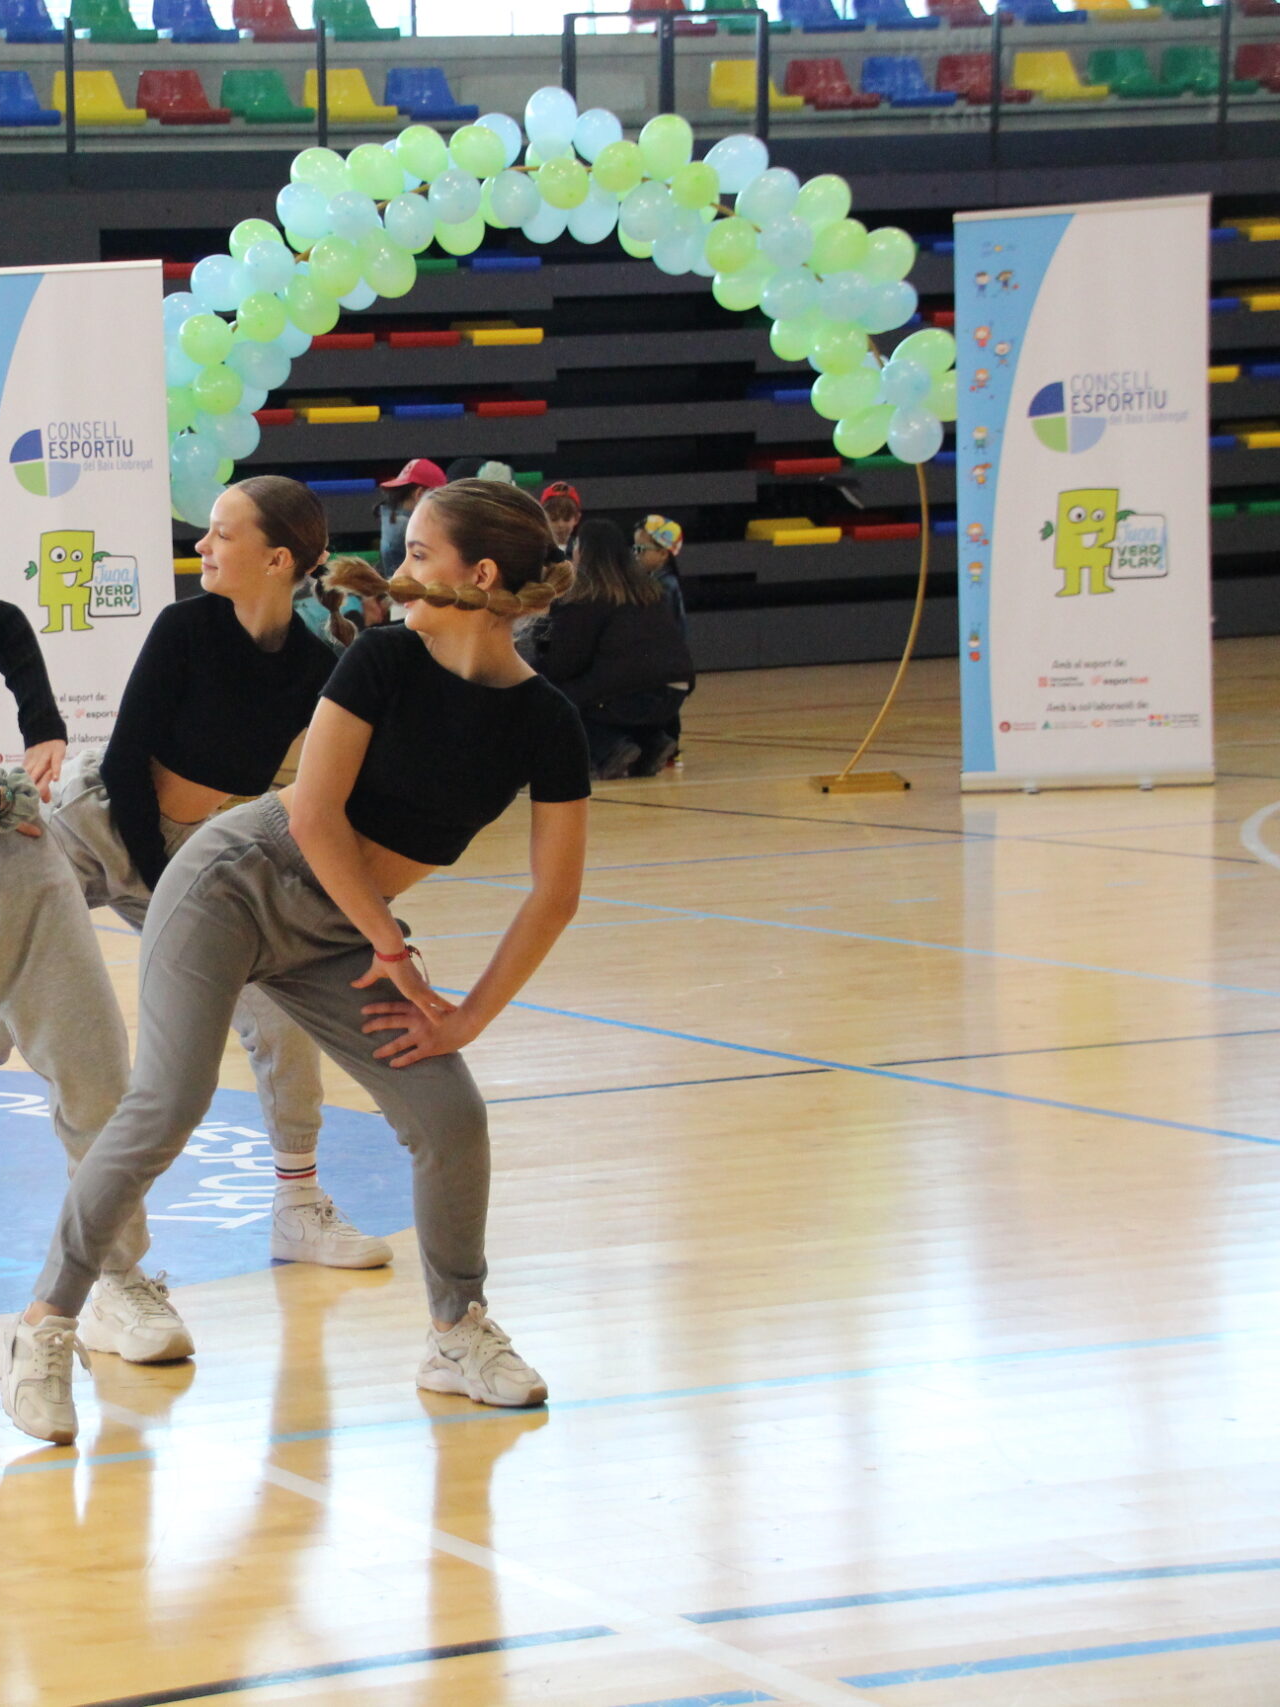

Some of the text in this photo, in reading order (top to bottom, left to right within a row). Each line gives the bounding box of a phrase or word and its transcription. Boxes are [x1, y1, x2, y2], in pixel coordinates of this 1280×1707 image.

[1070, 371, 1153, 394] CONSELL
[1071, 389, 1168, 414] ESPORTIU
[47, 420, 122, 441] CONSELL
[48, 438, 133, 460] ESPORTIU
[1117, 544, 1162, 557] VERD
[1118, 556, 1162, 569] PLAY
[94, 584, 133, 597] VERD
[96, 596, 133, 608] PLAY
